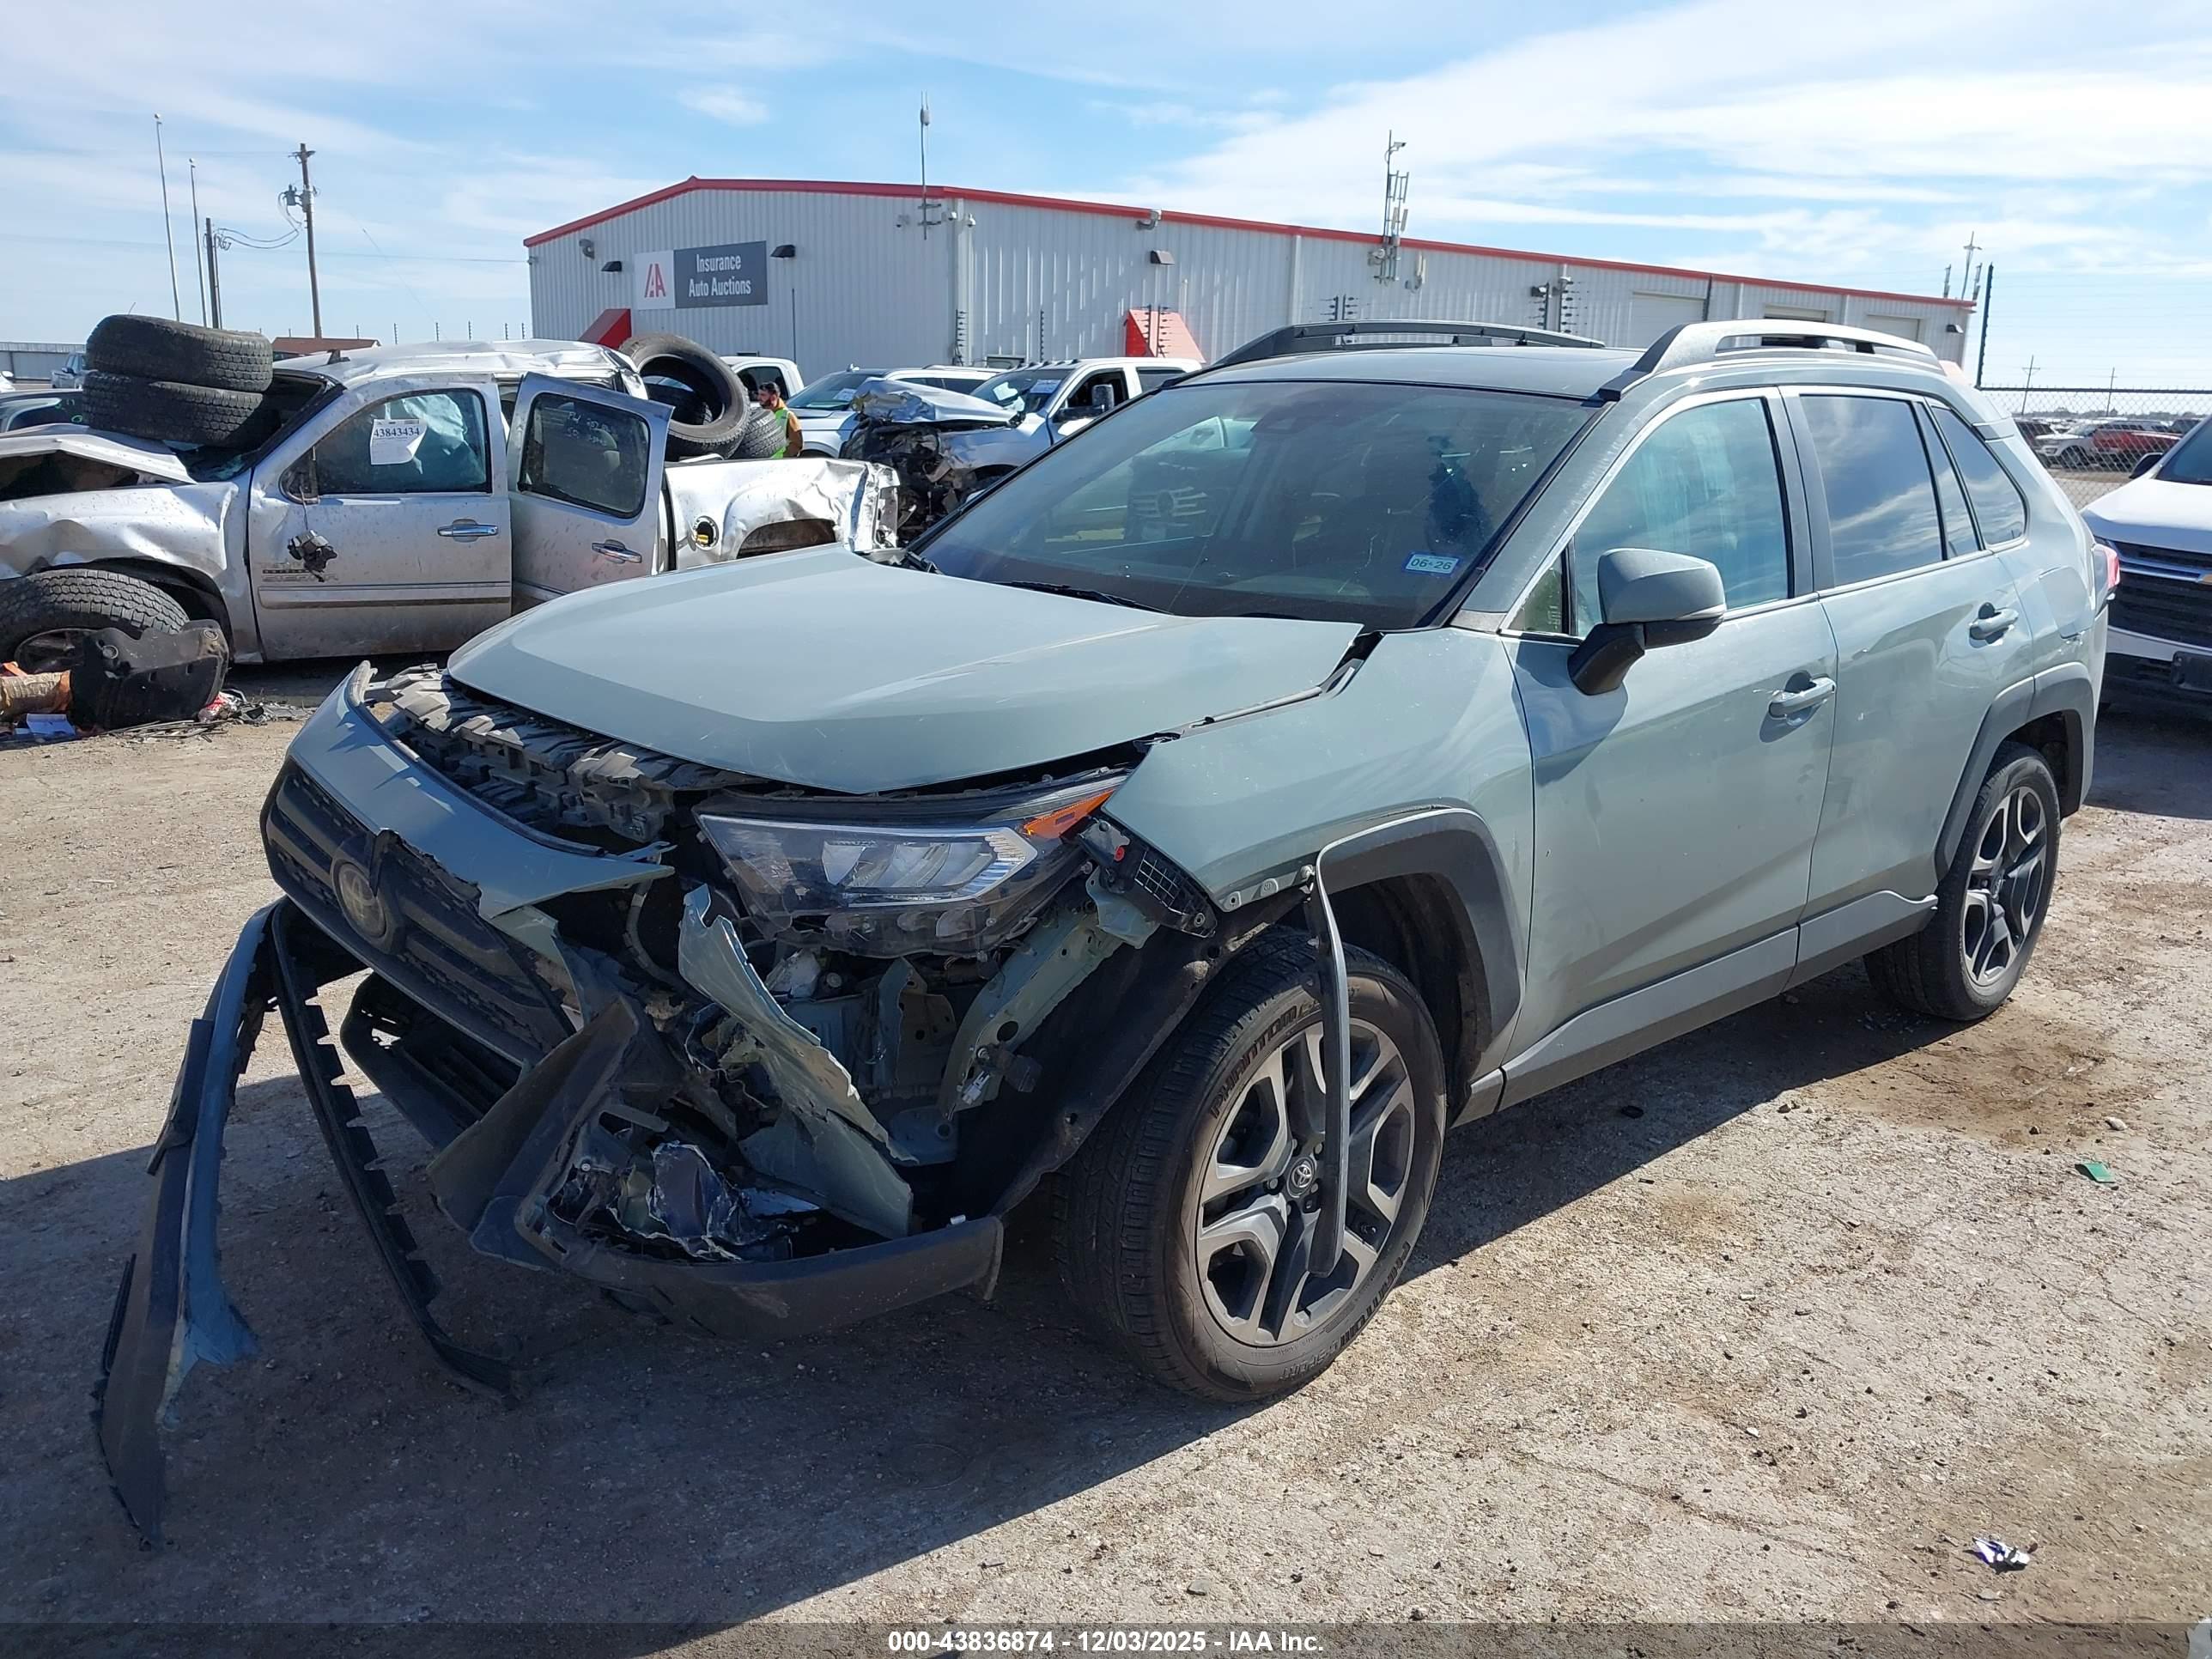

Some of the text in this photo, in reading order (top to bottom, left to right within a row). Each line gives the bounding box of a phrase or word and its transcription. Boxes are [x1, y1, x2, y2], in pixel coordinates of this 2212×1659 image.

[696, 253, 742, 273] Insurance
[689, 276, 752, 298] Auto Auctions
[373, 427, 420, 438] 43843434
[1209, 1004, 1298, 1120] PHANTOM
